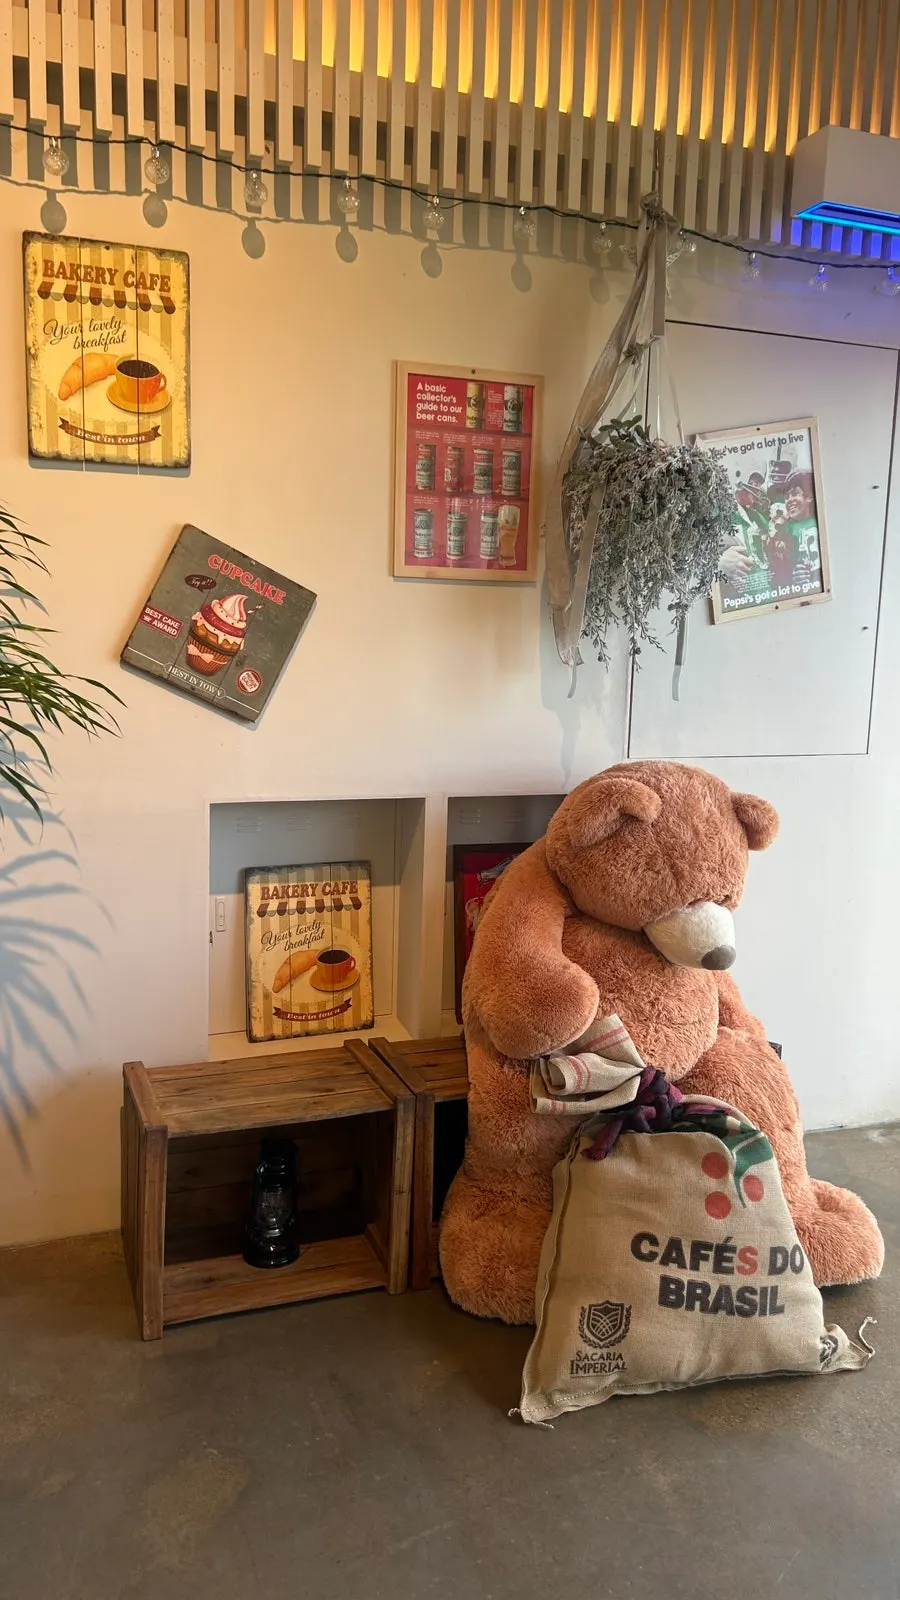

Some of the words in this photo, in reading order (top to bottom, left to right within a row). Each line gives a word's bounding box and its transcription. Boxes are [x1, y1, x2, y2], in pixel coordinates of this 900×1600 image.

[42, 259, 119, 286] BAKERY
[123, 270, 172, 293] CAFE
[43, 319, 83, 345] Your
[89, 316, 123, 336] lovely
[73, 330, 127, 352] breakfast
[416, 392, 457, 403] collector's
[417, 382, 423, 391] A
[424, 382, 447, 393] basic
[416, 401, 438, 411] guide
[440, 403, 448, 412] to
[449, 406, 463, 414] our
[416, 411, 435, 420] beer
[437, 414, 458, 423] cans.
[77, 429, 101, 441] Best
[103, 435, 115, 443] in
[117, 436, 145, 444] town
[740, 441, 755, 454] got
[764, 437, 776, 448] lot
[778, 436, 787, 445] to
[788, 433, 804, 443] live
[207, 553, 287, 606] CUPCAKE
[723, 593, 754, 608] Pepsi's
[754, 590, 770, 603] got
[771, 589, 778, 597] a
[778, 585, 790, 596] lot
[791, 584, 801, 593] to
[801, 580, 820, 593] give
[144, 607, 163, 619] BEST
[162, 616, 181, 629] CAKE
[151, 619, 178, 635] AWARD
[168, 665, 190, 680] BEST
[189, 676, 199, 685] IN
[260, 883, 319, 900] BAKERY
[321, 880, 358, 896] CAFE
[260, 929, 292, 951] Your
[295, 919, 322, 938] lovely
[284, 928, 326, 951] breakfast
[630, 1232, 759, 1276] CAFÉS
[767, 1243, 805, 1277] DO
[657, 1273, 786, 1318] BRASIL
[575, 1350, 624, 1362] SACARIA
[570, 1360, 627, 1375] IMPERIAL
